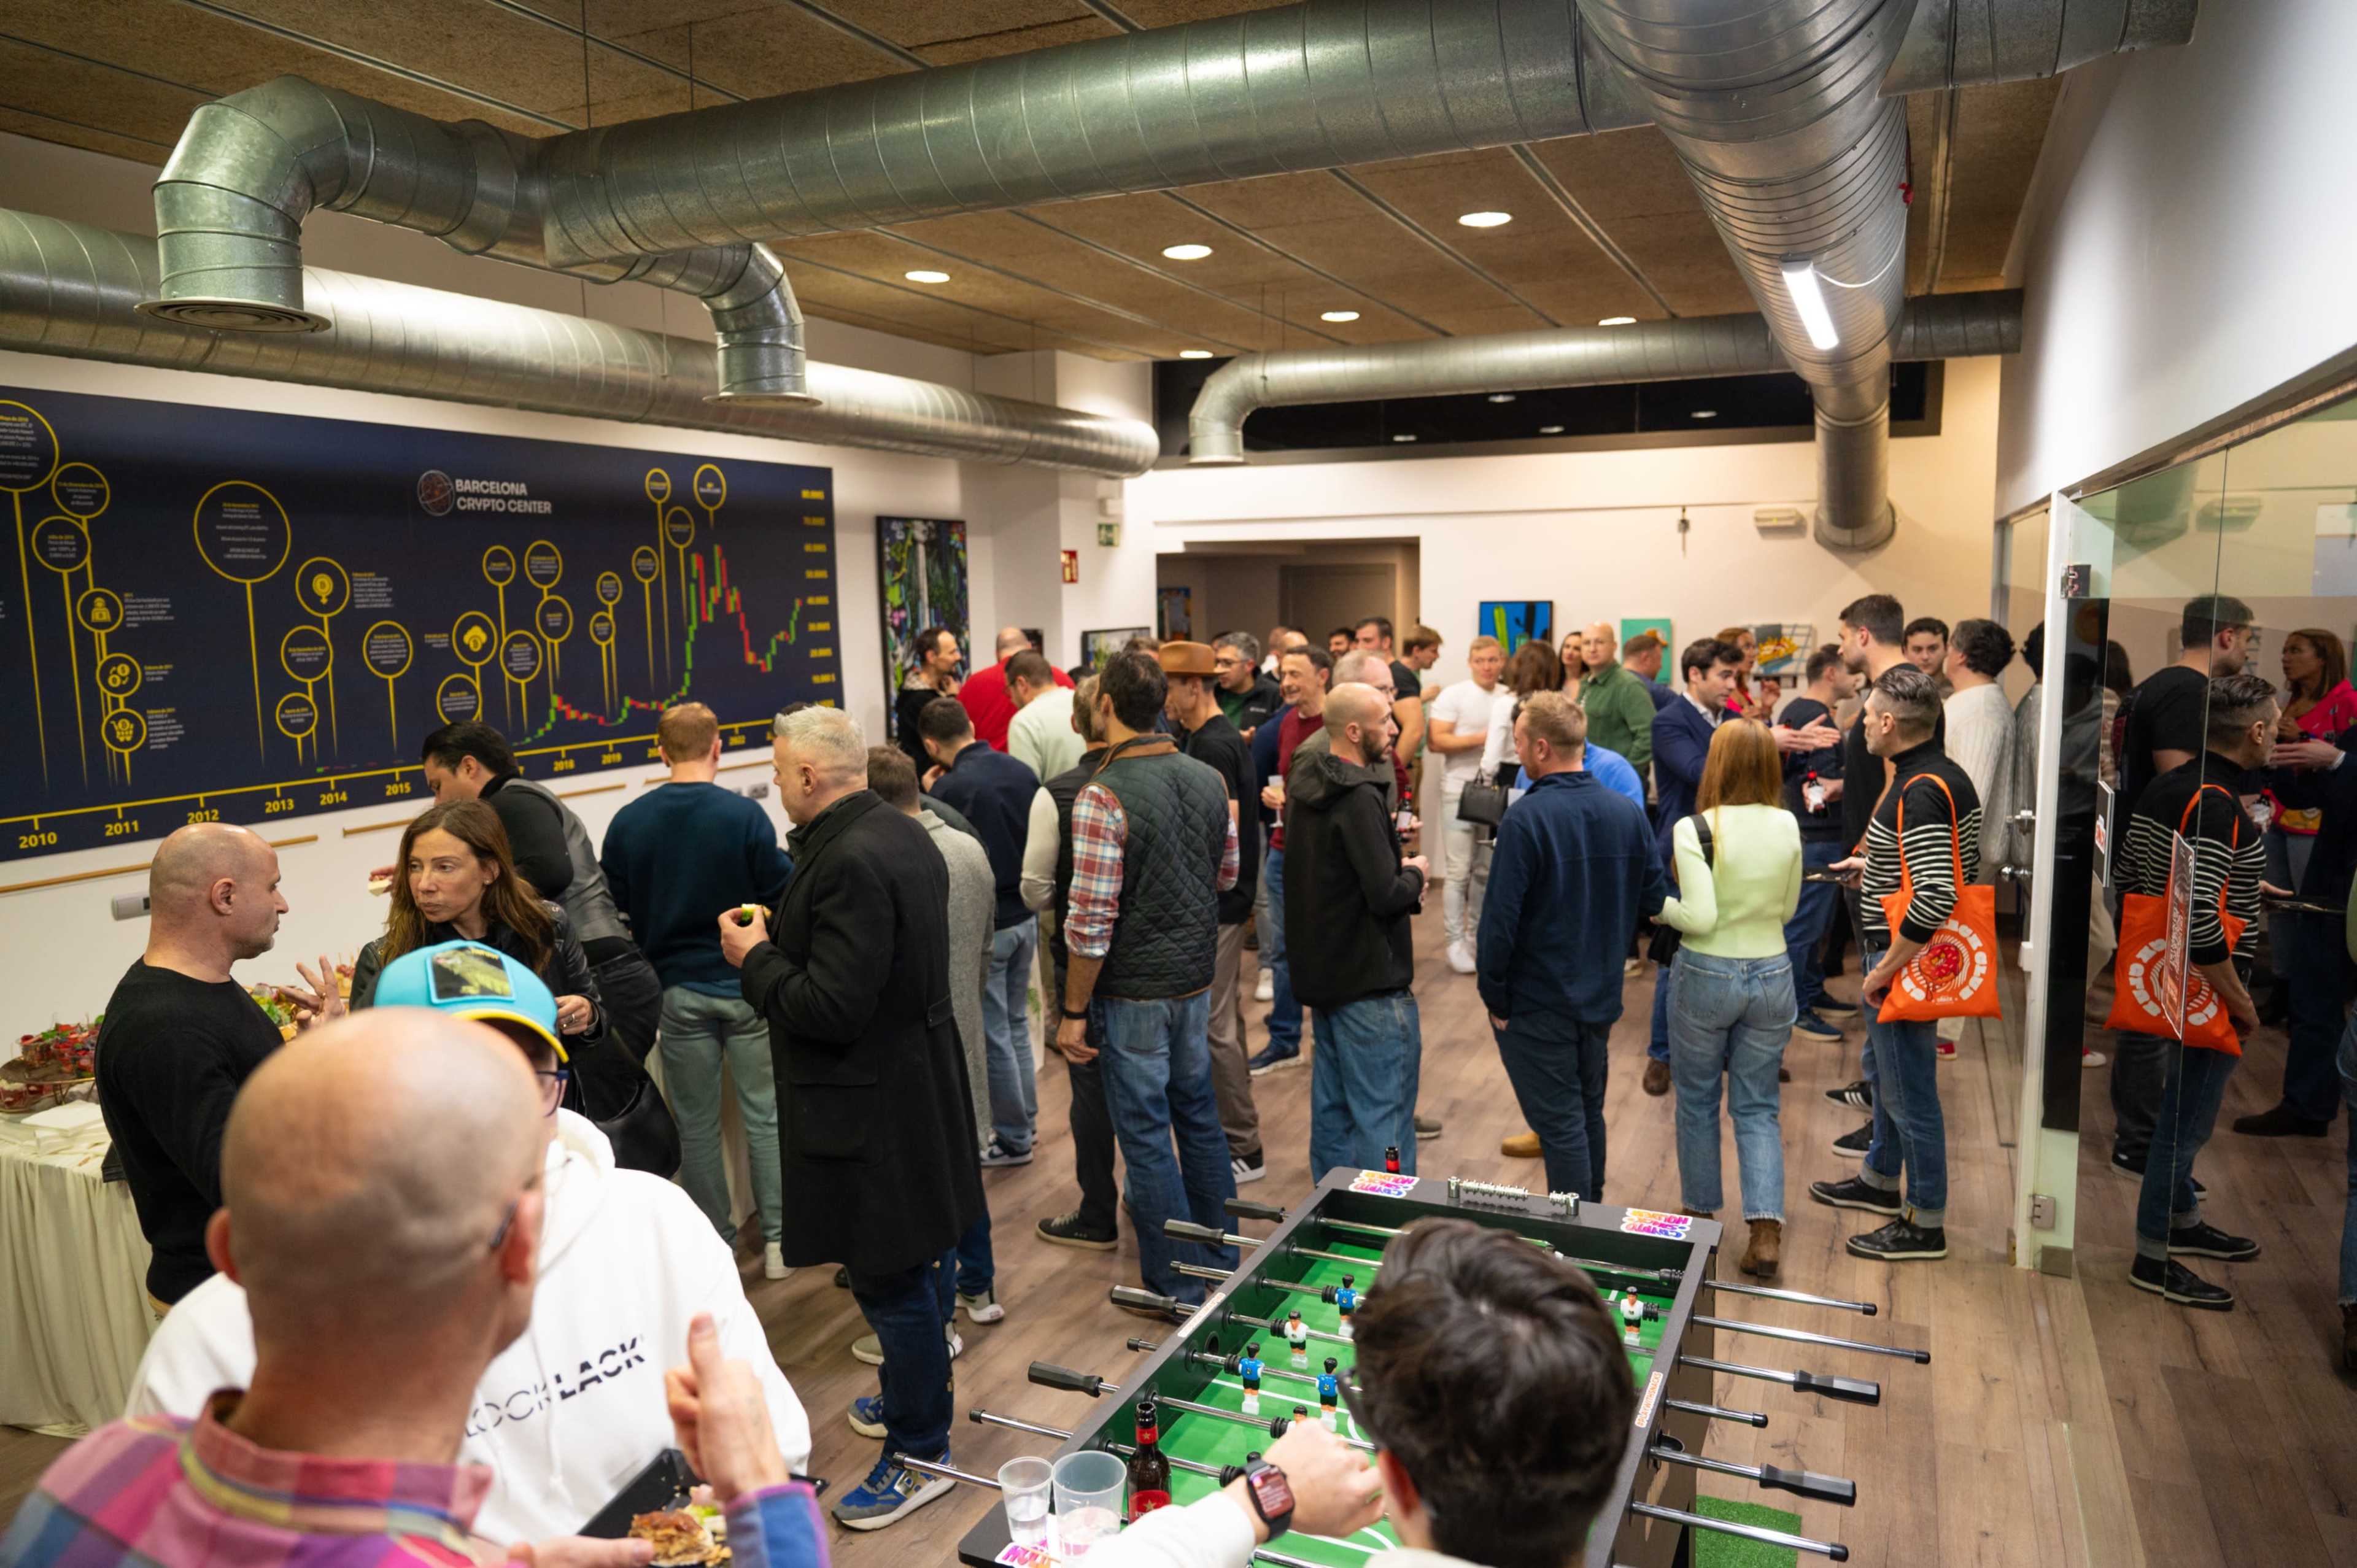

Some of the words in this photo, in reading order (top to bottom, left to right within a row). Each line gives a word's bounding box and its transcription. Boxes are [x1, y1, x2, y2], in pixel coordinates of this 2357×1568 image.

[455, 479, 528, 496] BARCELONA
[457, 497, 506, 511] CRYPTO
[508, 500, 552, 514] CENTER
[19, 832, 58, 849] 2010
[104, 820, 139, 836] 2011
[187, 809, 220, 824] 2012
[265, 798, 295, 813] 2013
[320, 791, 348, 805] 2014
[385, 782, 411, 796] 2015
[554, 759, 575, 771] 2018
[1959, 951, 1988, 1001] CLUB
[1625, 1223, 1683, 1238] CRYPTO
